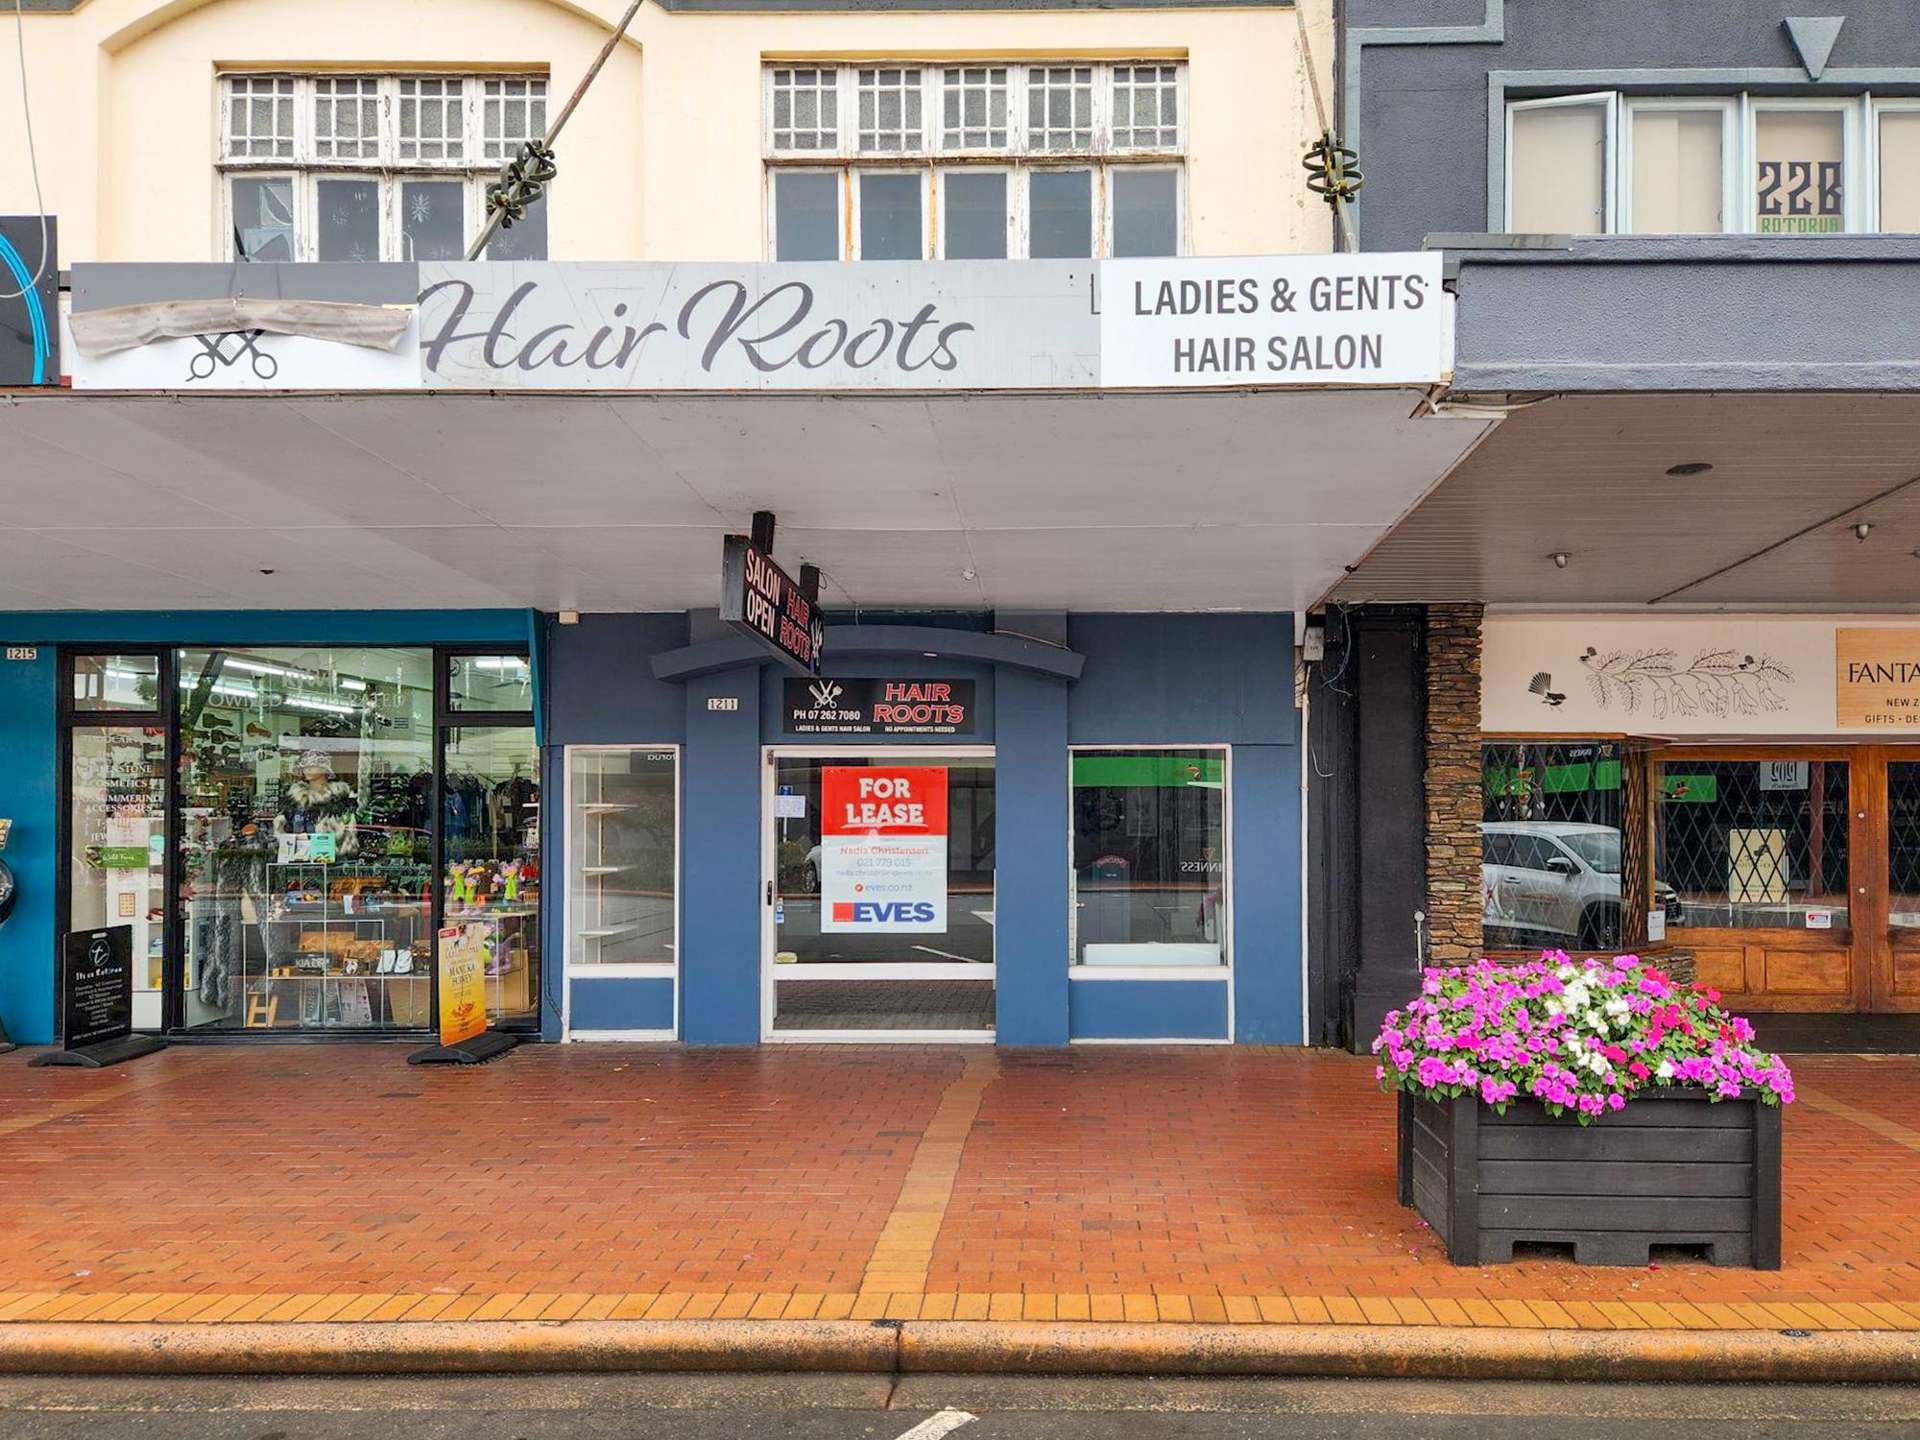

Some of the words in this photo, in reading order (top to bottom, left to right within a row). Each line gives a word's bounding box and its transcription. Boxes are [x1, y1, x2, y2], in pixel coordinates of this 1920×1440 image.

[1761, 217, 1839, 233] ROTORUA
[1134, 278, 1260, 316] LADIES
[1270, 277, 1297, 313] &
[1309, 273, 1426, 313] GENTS
[418, 279, 668, 373] Hair
[676, 279, 976, 373] Roots
[1174, 337, 1257, 374] HAIR
[1266, 333, 1383, 372] SALON
[746, 548, 781, 607] SALON
[747, 588, 776, 638] OPEN
[786, 587, 810, 632] HAIR
[780, 614, 811, 662] ROOTS
[7, 648, 36, 659] 1215
[1848, 662, 1920, 683] FANTA
[885, 682, 951, 702] HAIR
[1886, 698, 1910, 707] NEW
[708, 699, 738, 710] 1211
[793, 709, 807, 720] PH
[808, 710, 819, 720] 07
[820, 710, 837, 720] 262
[873, 703, 965, 724] ROOTS
[1864, 714, 1896, 724] GIFTS
[1905, 714, 1920, 724] DE
[859, 778, 911, 799] FOR
[845, 803, 924, 824] LEASE
[856, 858, 873, 867] 021
[875, 858, 893, 867] 779
[854, 902, 935, 923] EVES
